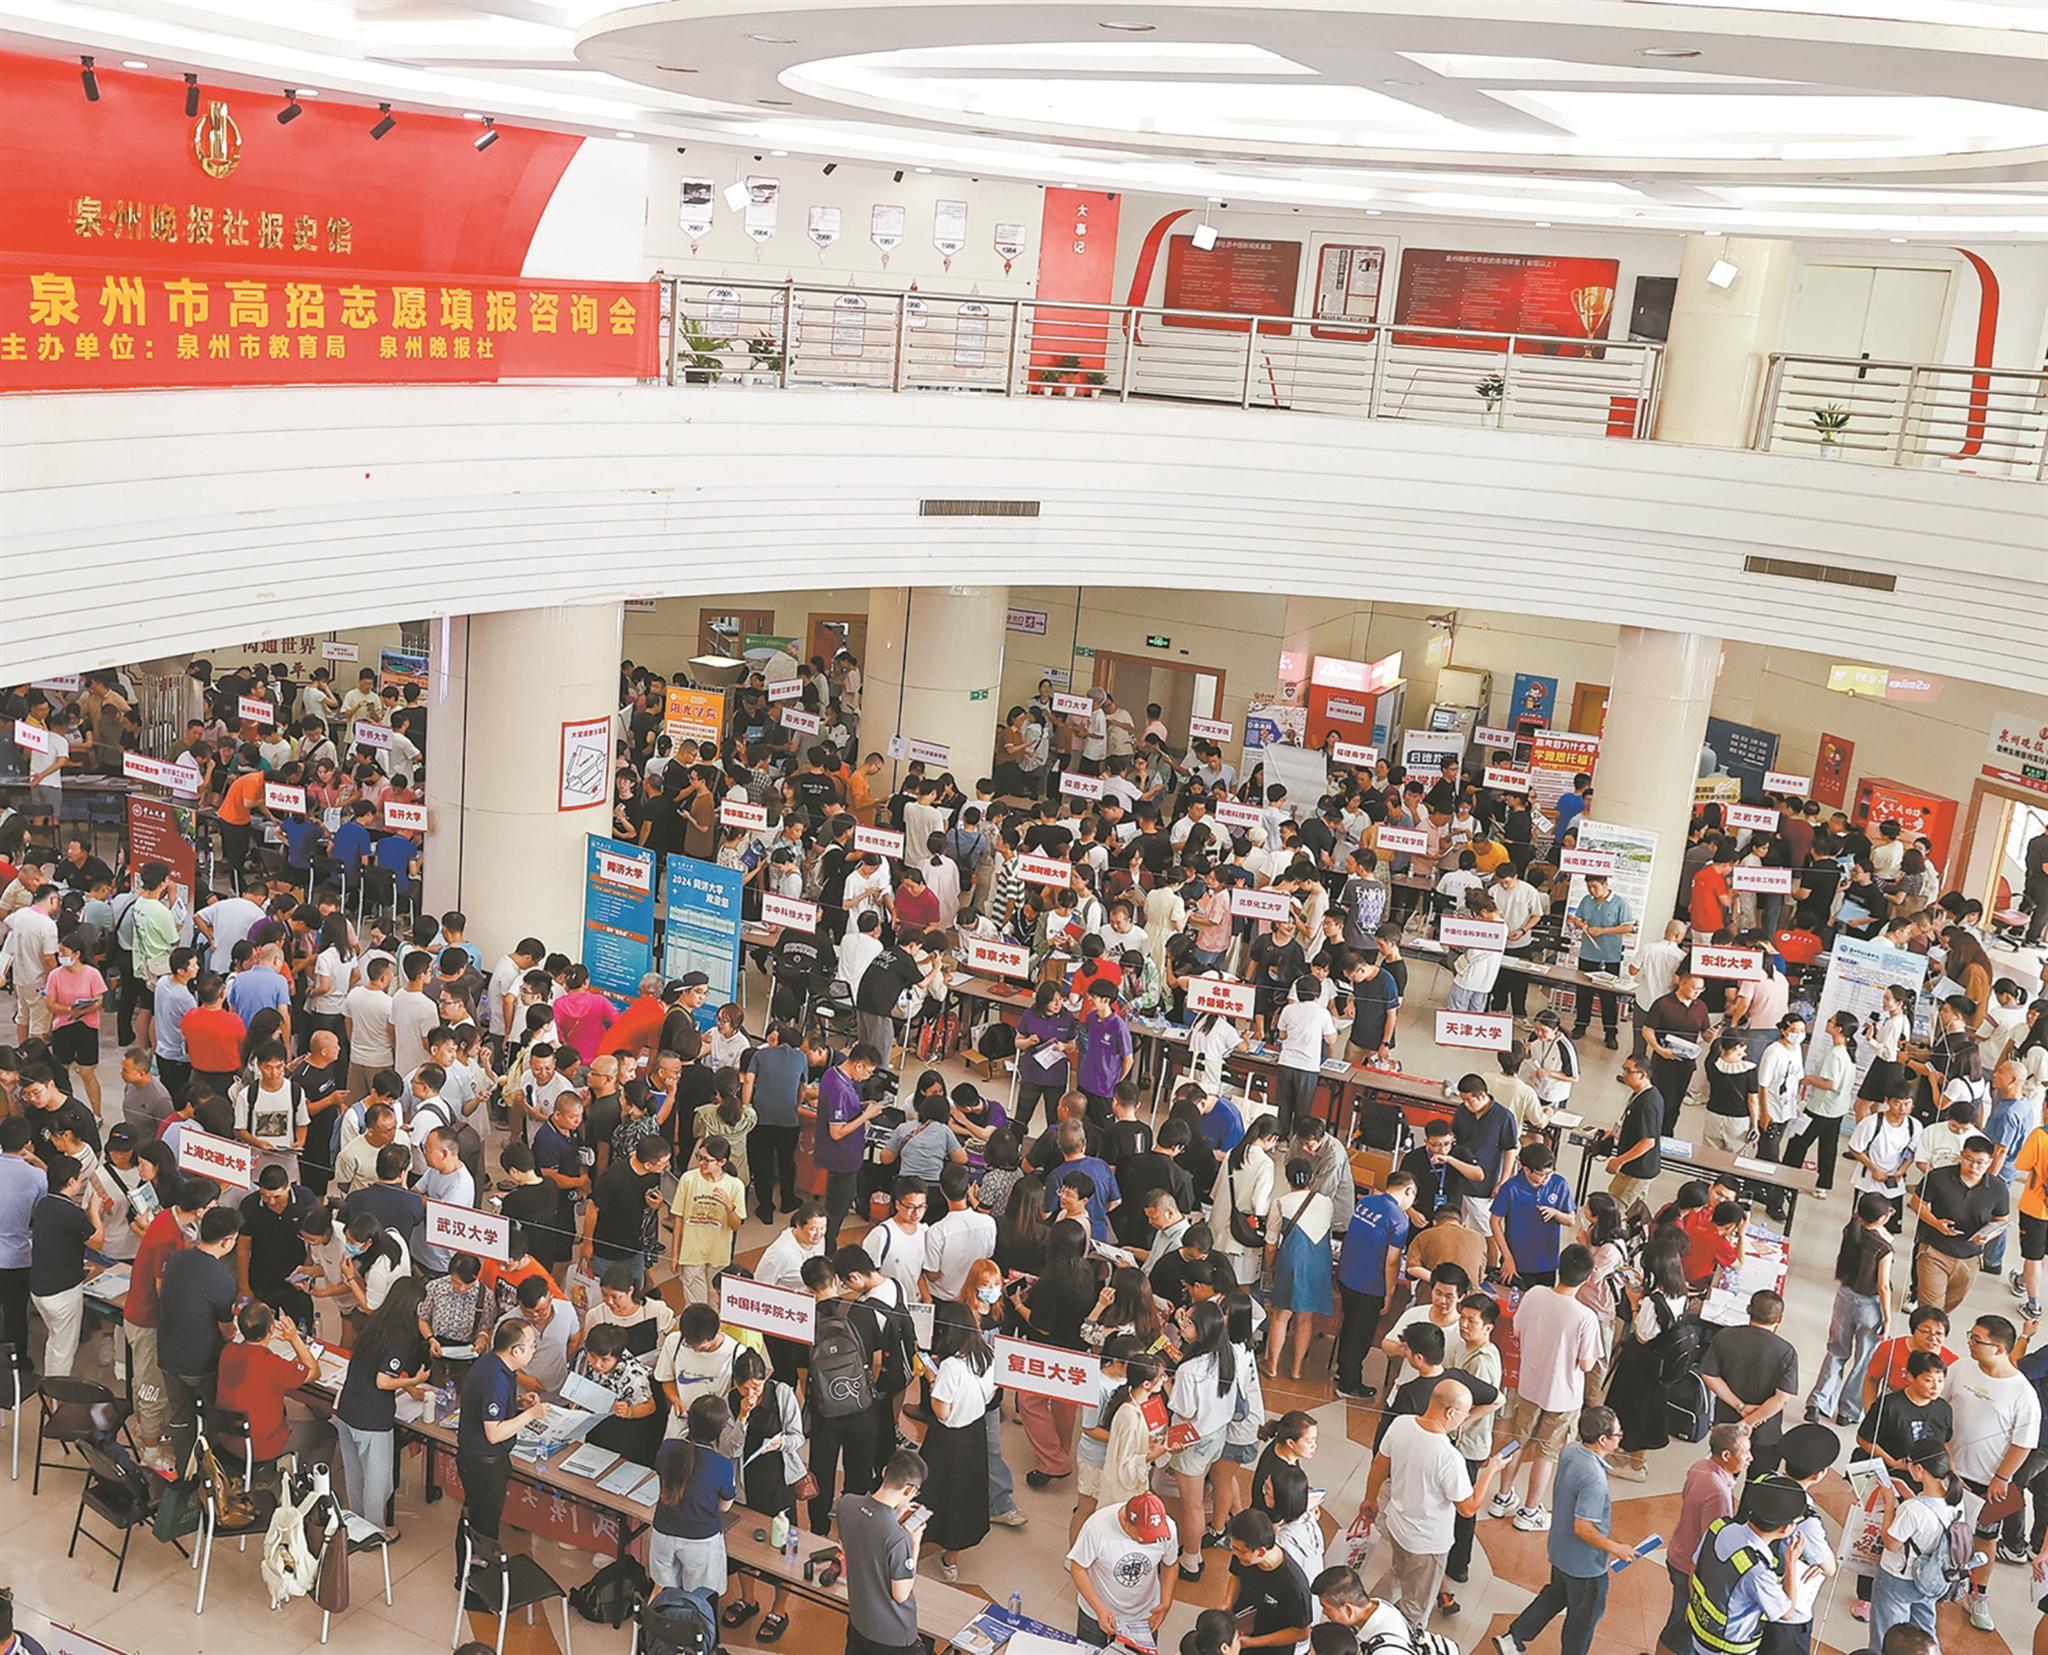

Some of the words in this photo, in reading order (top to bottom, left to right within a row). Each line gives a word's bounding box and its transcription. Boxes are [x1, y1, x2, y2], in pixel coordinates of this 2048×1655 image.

[73, 195, 353, 254] 泉州晚报社报史馆
[29, 272, 636, 336] 泉州市高招志愿填报咨询会
[176, 333, 347, 361] 泉州市教育局
[378, 335, 496, 360] 泉州晚报社
[670, 702, 718, 720] 阳光学院
[1056, 698, 1088, 710] 厦门大学
[784, 713, 817, 730] 阳光学院
[1192, 722, 1230, 737] 厦门理工学院
[359, 727, 390, 742] 华侨大学
[1999, 728, 2048, 752] 泉州晚报
[1336, 749, 1374, 762] 福建商学院
[1063, 778, 1099, 793] 仰恩大学
[1487, 772, 1526, 786] 厦门医学院
[269, 791, 301, 806] 中山大学
[389, 806, 423, 823] 南开大学
[1218, 809, 1260, 822] 闽南科技学院
[1732, 811, 1774, 827] 龙岩学院
[857, 835, 902, 849] 华南师范大学
[1379, 833, 1425, 848] 新疆工程学院
[606, 860, 644, 880] 同济大学
[1020, 862, 1068, 878] 上海财经大学
[1563, 856, 1611, 869] 闽南理工学院
[672, 873, 692, 888] 2024
[693, 877, 724, 895] 同济大学
[765, 903, 814, 923] 华中科技大学
[1238, 898, 1282, 913] 北京化工大学
[1443, 928, 1500, 942] 中国社会科学院大学
[974, 946, 1021, 966] 南京大学
[1700, 953, 1754, 970] 东北大学
[1211, 985, 1232, 997] 北京
[1196, 996, 1244, 1012] 外国语大学
[1445, 1021, 1502, 1040] 天津大学
[182, 1141, 247, 1174] 上海交通大学
[436, 1216, 499, 1246] 武汉大学
[726, 1293, 809, 1326] 中国科学院大学
[1006, 1352, 1088, 1387] 复旦大学
[137, 1382, 161, 1402] NBA
